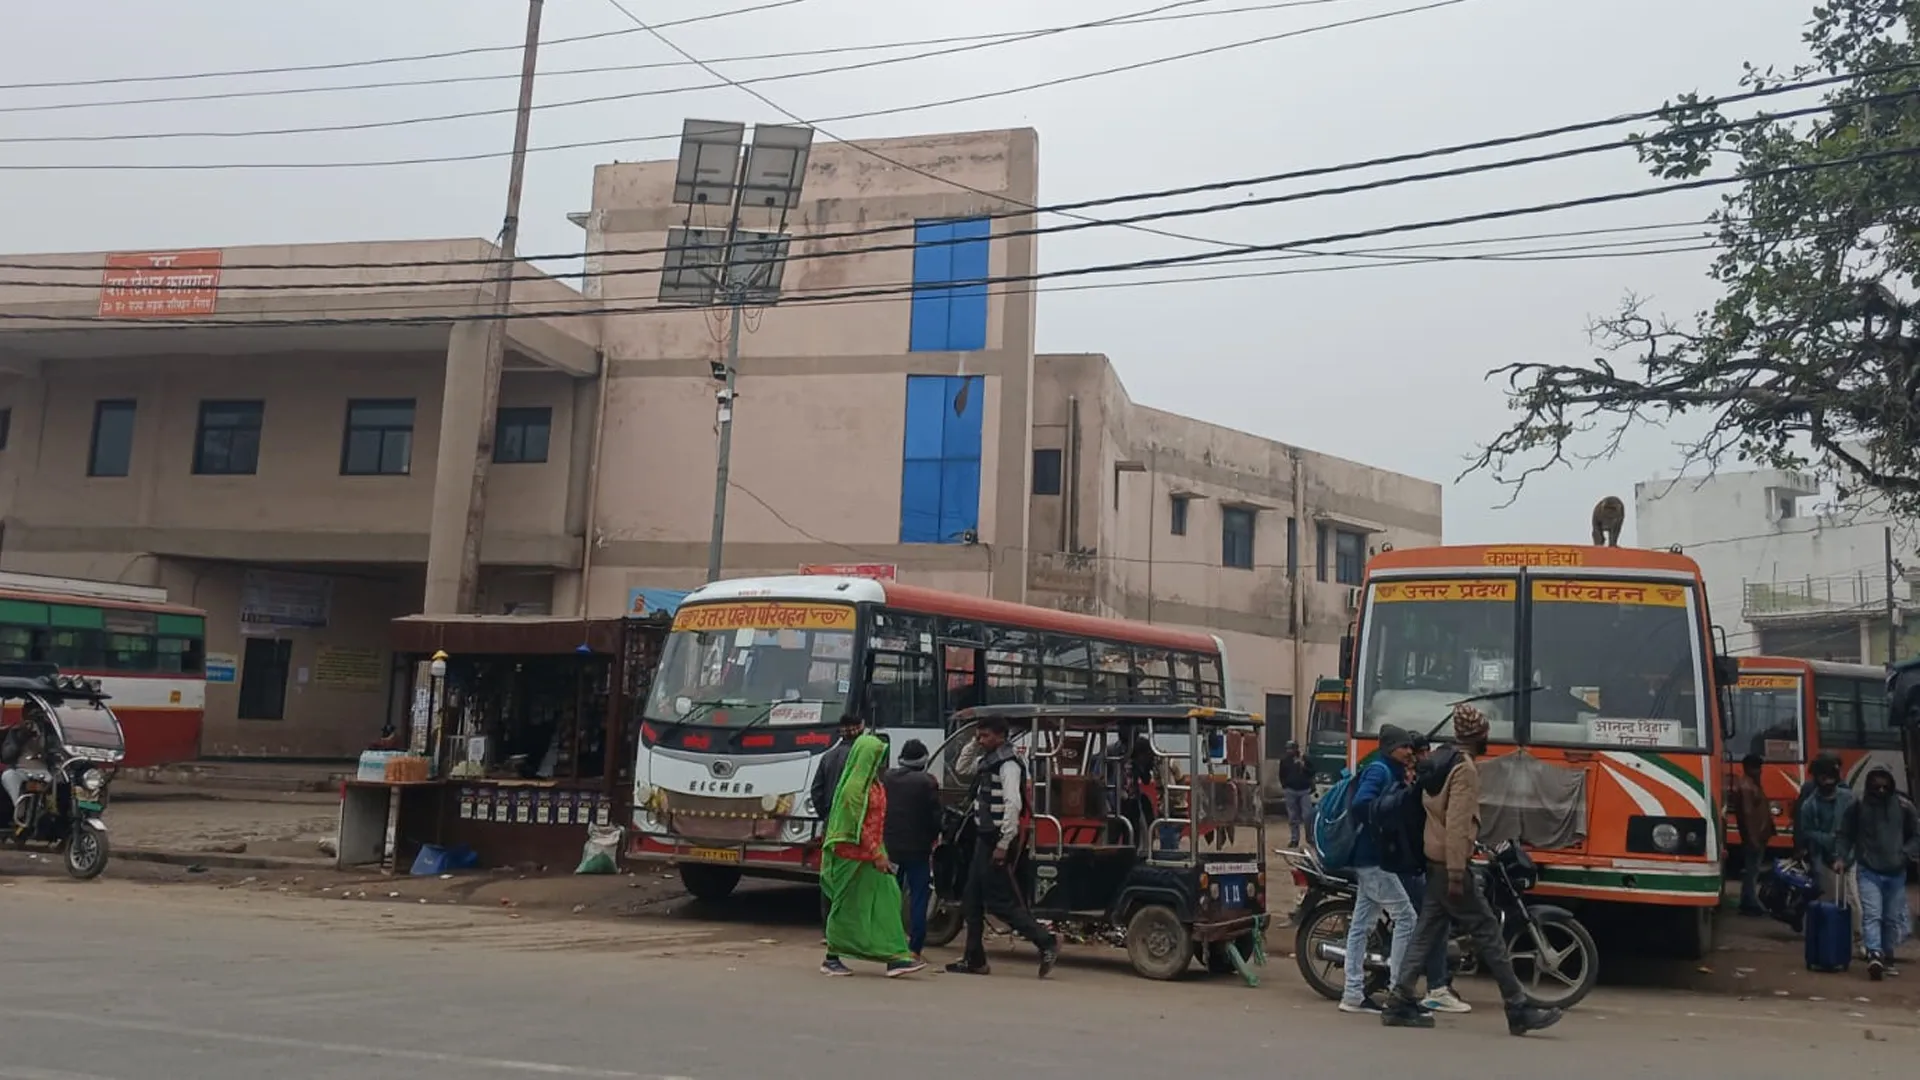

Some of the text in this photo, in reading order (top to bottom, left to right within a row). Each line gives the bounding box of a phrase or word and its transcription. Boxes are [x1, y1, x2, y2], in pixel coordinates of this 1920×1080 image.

[1486, 549, 1541, 566] कासगंज
[1403, 580, 1646, 602] उत्तर प्रदेश परिवहन
[697, 602, 808, 626] उत्तर प्रदेश परिवहन
[1594, 718, 1671, 733] आनन्द विहार
[689, 781, 754, 794] EICHER
